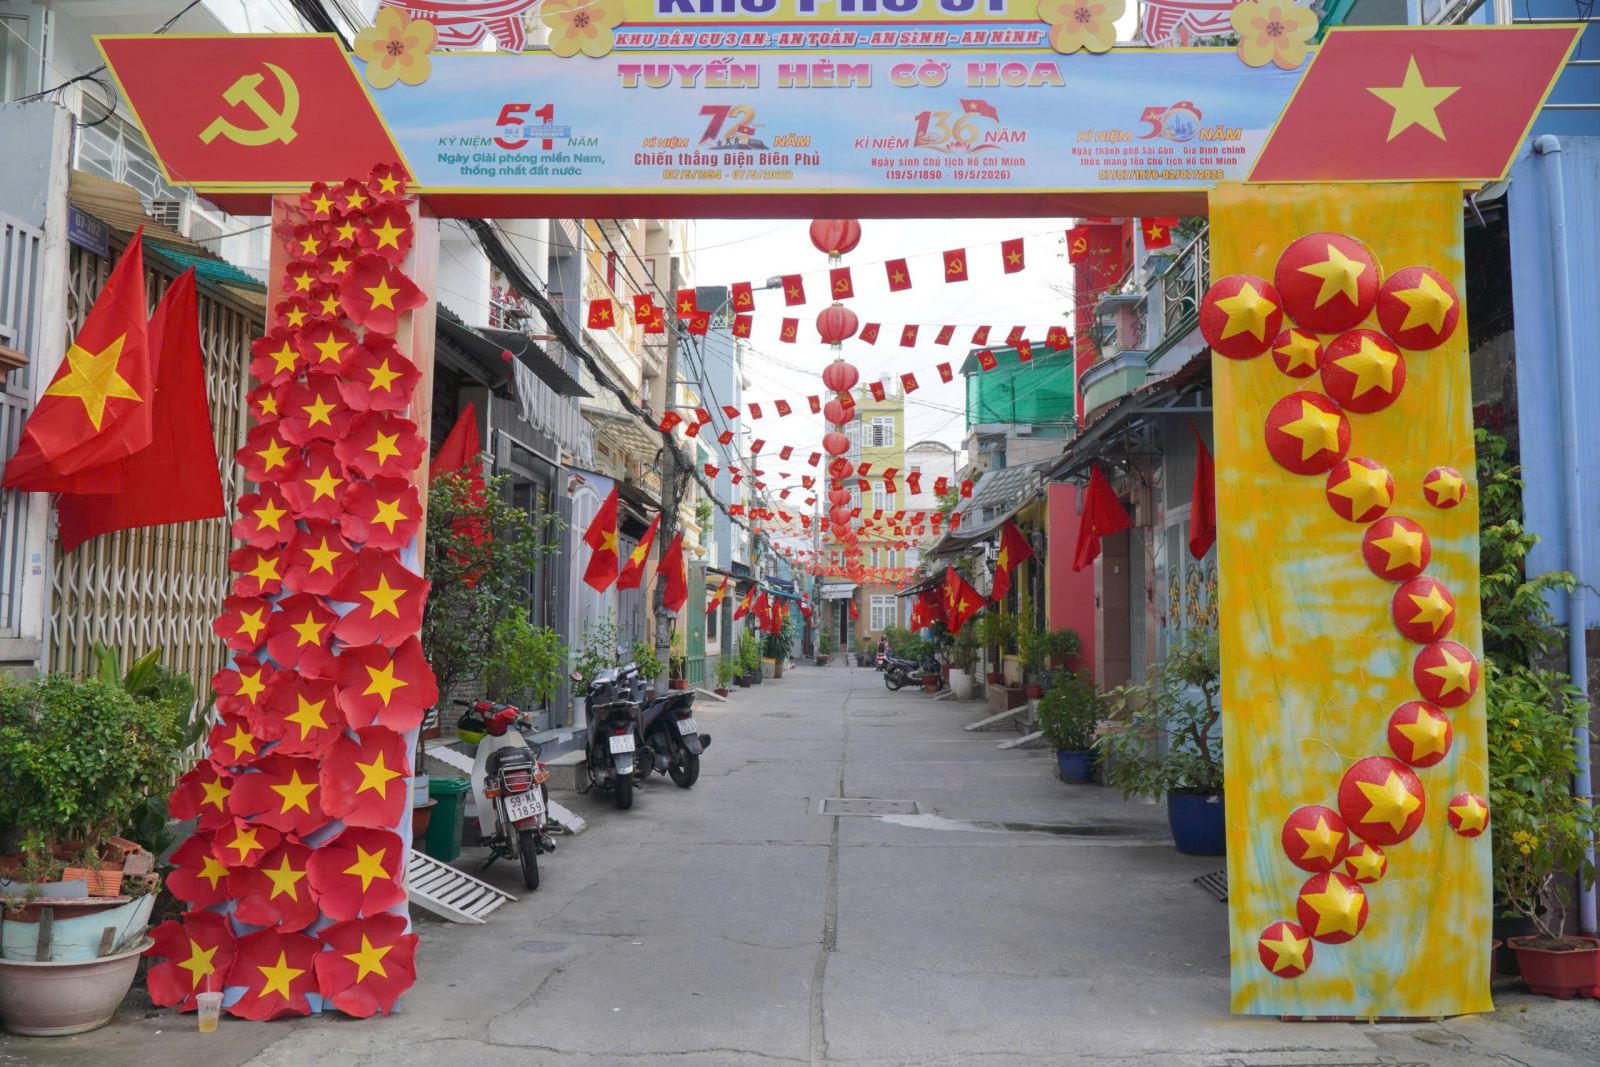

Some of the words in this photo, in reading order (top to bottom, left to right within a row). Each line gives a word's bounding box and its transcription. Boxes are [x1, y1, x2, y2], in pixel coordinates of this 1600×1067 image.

[616, 33, 655, 45] KHU
[658, 30, 696, 45] DÂN
[699, 32, 724, 45] CƯ
[726, 32, 737, 45] 3
[741, 32, 770, 45] AN:
[808, 29, 858, 44] TOÀN
[871, 31, 898, 44] AN
[961, 31, 989, 43] AN
[617, 57, 759, 88] TUYẾN
[777, 57, 872, 88] HẺM
[890, 58, 950, 88] CỜ
[967, 61, 1066, 87] HOA
[460, 135, 493, 148] NIỆM
[494, 103, 554, 151] 51
[567, 135, 599, 147] NĂM
[658, 136, 690, 149] NIỆM
[698, 104, 757, 147] 72
[774, 132, 811, 148] NĂM
[1095, 129, 1133, 143] NIỆM
[1136, 101, 1203, 143] 50
[1199, 124, 1242, 141] NĂM
[872, 136, 909, 150] NIỆM
[913, 111, 980, 148] 136
[985, 128, 1026, 142] NĂM
[437, 153, 469, 164] Ngày
[472, 152, 496, 163] Giải
[498, 152, 538, 165] phóng
[573, 153, 605, 165] Nam,
[634, 151, 673, 165] Chiến
[678, 150, 718, 167] thắng
[723, 151, 754, 168] Điện
[759, 151, 789, 166] Biên
[794, 150, 820, 166] Phủ
[1072, 147, 1092, 156] Ngày
[1095, 146, 1120, 155] thành
[1142, 146, 1155, 155] Sài
[1158, 146, 1174, 155] Gòn
[1183, 146, 1197, 155] Gia
[1199, 146, 1219, 156] Định
[871, 157, 895, 167] Ngày
[898, 157, 919, 166] sinh
[923, 156, 941, 166] Chủ
[944, 157, 964, 168] tịch
[967, 156, 979, 166] Hồ
[982, 156, 998, 166] Chí
[1001, 157, 1026, 166] Minh
[1103, 158, 1128, 167] mang
[1130, 157, 1144, 166] tên
[1147, 156, 1163, 166] Chủ
[1166, 157, 1183, 167] tịch
[1186, 156, 1197, 166] Hồ
[1215, 157, 1238, 166] Minh
[460, 164, 496, 177] thống
[498, 164, 527, 175] nhất
[529, 164, 549, 176] đất
[552, 166, 583, 176] nước
[886, 170, 942, 180] (19/5/1890
[953, 170, 1010, 180] 19/5/2026)
[500, 754, 525, 762] HONDA
[511, 802, 542, 819] 118.59
